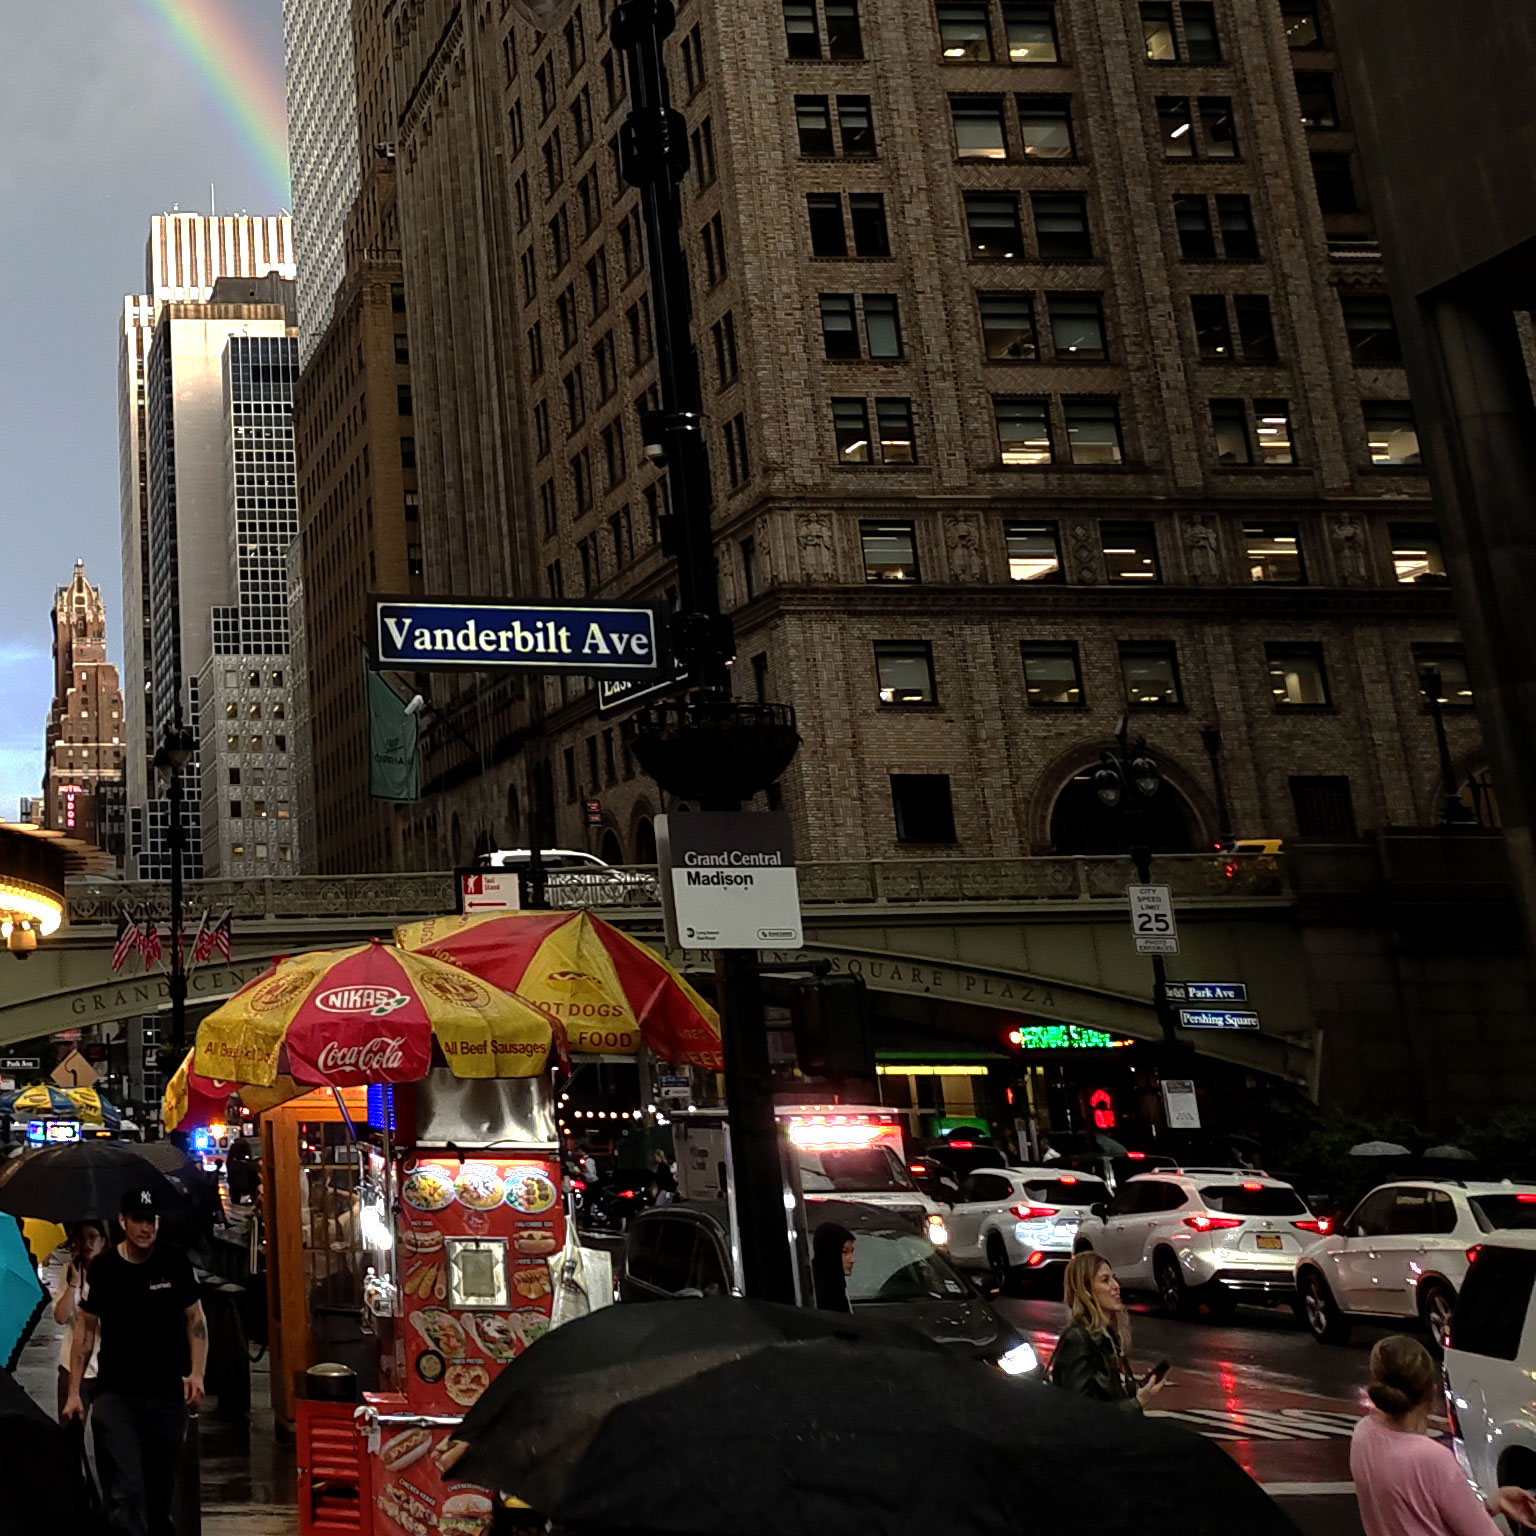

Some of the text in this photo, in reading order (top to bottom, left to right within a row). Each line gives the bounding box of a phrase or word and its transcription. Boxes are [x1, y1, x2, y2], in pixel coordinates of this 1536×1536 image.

[384, 618, 649, 655] Vanderbilt Ave
[684, 851, 782, 866] Grand Central
[687, 871, 754, 886] Madison
[1138, 913, 1170, 932] 25
[831, 957, 943, 985] SQUARE
[966, 975, 1054, 1006] PLAZA
[72, 982, 170, 1014] GRAND
[328, 989, 390, 1009] NIKAS
[1188, 987, 1214, 998] Park
[1215, 987, 1235, 998] Ave
[534, 1001, 624, 1017] OT DOGS
[1183, 1012, 1257, 1029] Pershing Square
[578, 1031, 632, 1047] FOOD
[444, 1039, 547, 1057] All Beef Sausages
